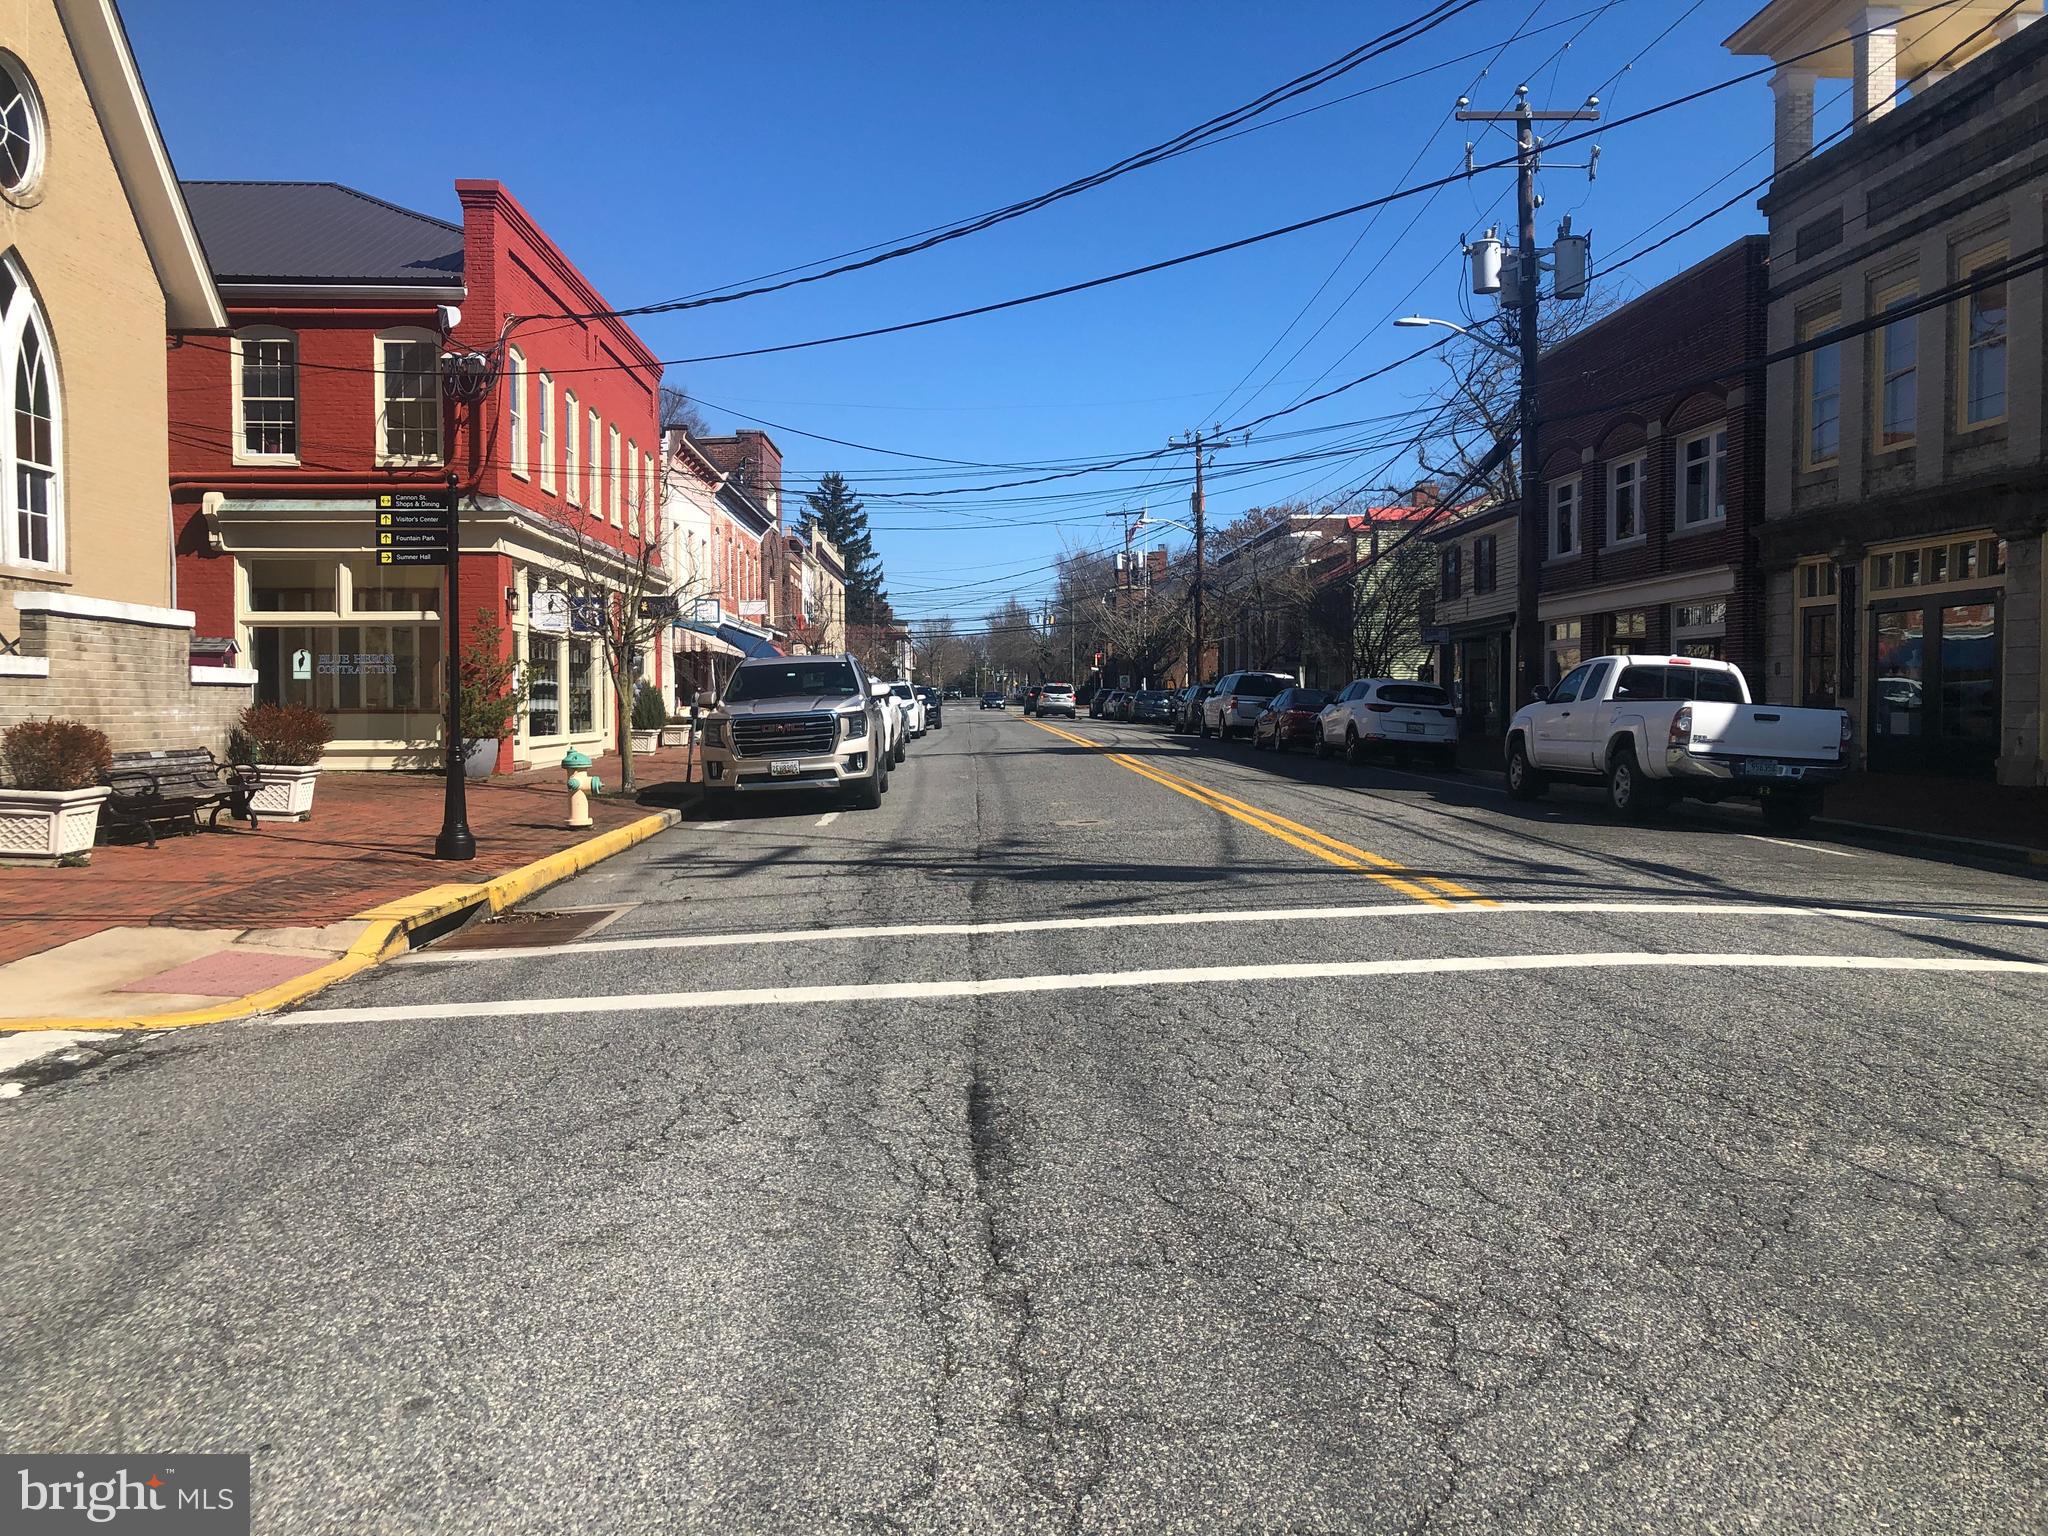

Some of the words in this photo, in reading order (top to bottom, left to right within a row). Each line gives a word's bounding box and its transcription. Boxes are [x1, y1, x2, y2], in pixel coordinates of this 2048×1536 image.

[318, 654, 350, 664] BLUE
[353, 654, 395, 664] HERON
[317, 665, 397, 675] CONTRACTING
[761, 722, 805, 734] GMC
